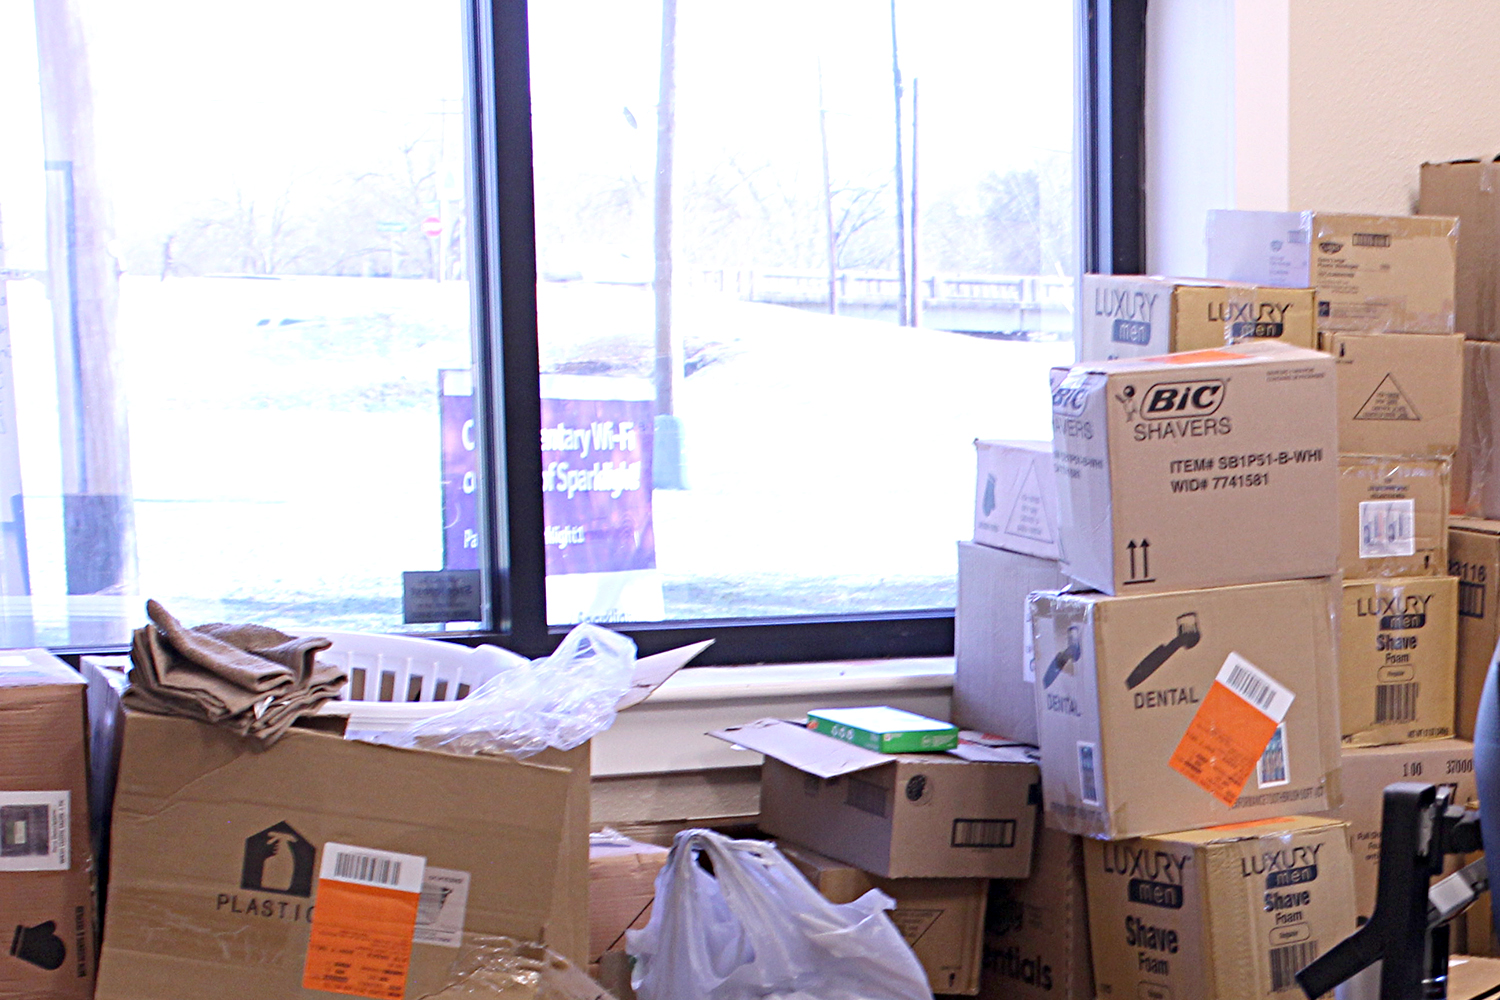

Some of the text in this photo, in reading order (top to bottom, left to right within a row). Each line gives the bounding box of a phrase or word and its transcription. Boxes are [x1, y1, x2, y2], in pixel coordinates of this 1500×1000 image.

[1095, 287, 1158, 321] LUXURY
[1208, 301, 1287, 324] LUXURY
[1119, 323, 1146, 343] men
[1241, 323, 1277, 337] men
[591, 421, 636, 452] Wi-Fi
[1134, 417, 1232, 442] SHAVERS
[1170, 460, 1214, 474] ITEM#
[1170, 472, 1270, 494] WID# 7741581
[1356, 594, 1432, 617] LUXURY
[1390, 616, 1421, 628] men
[1376, 633, 1418, 652] Shave
[1385, 653, 1410, 665] Foam
[1047, 693, 1082, 718] DENTAL
[1134, 687, 1200, 710] DENTAL
[1103, 843, 1186, 886] LUXURY
[1241, 844, 1321, 878] LUXURY
[1275, 869, 1312, 887] men
[1138, 883, 1177, 906] men
[1263, 890, 1311, 913] Shave
[1275, 910, 1303, 926] Foam
[1125, 914, 1179, 954] Shave
[1138, 951, 1169, 977] Foam
